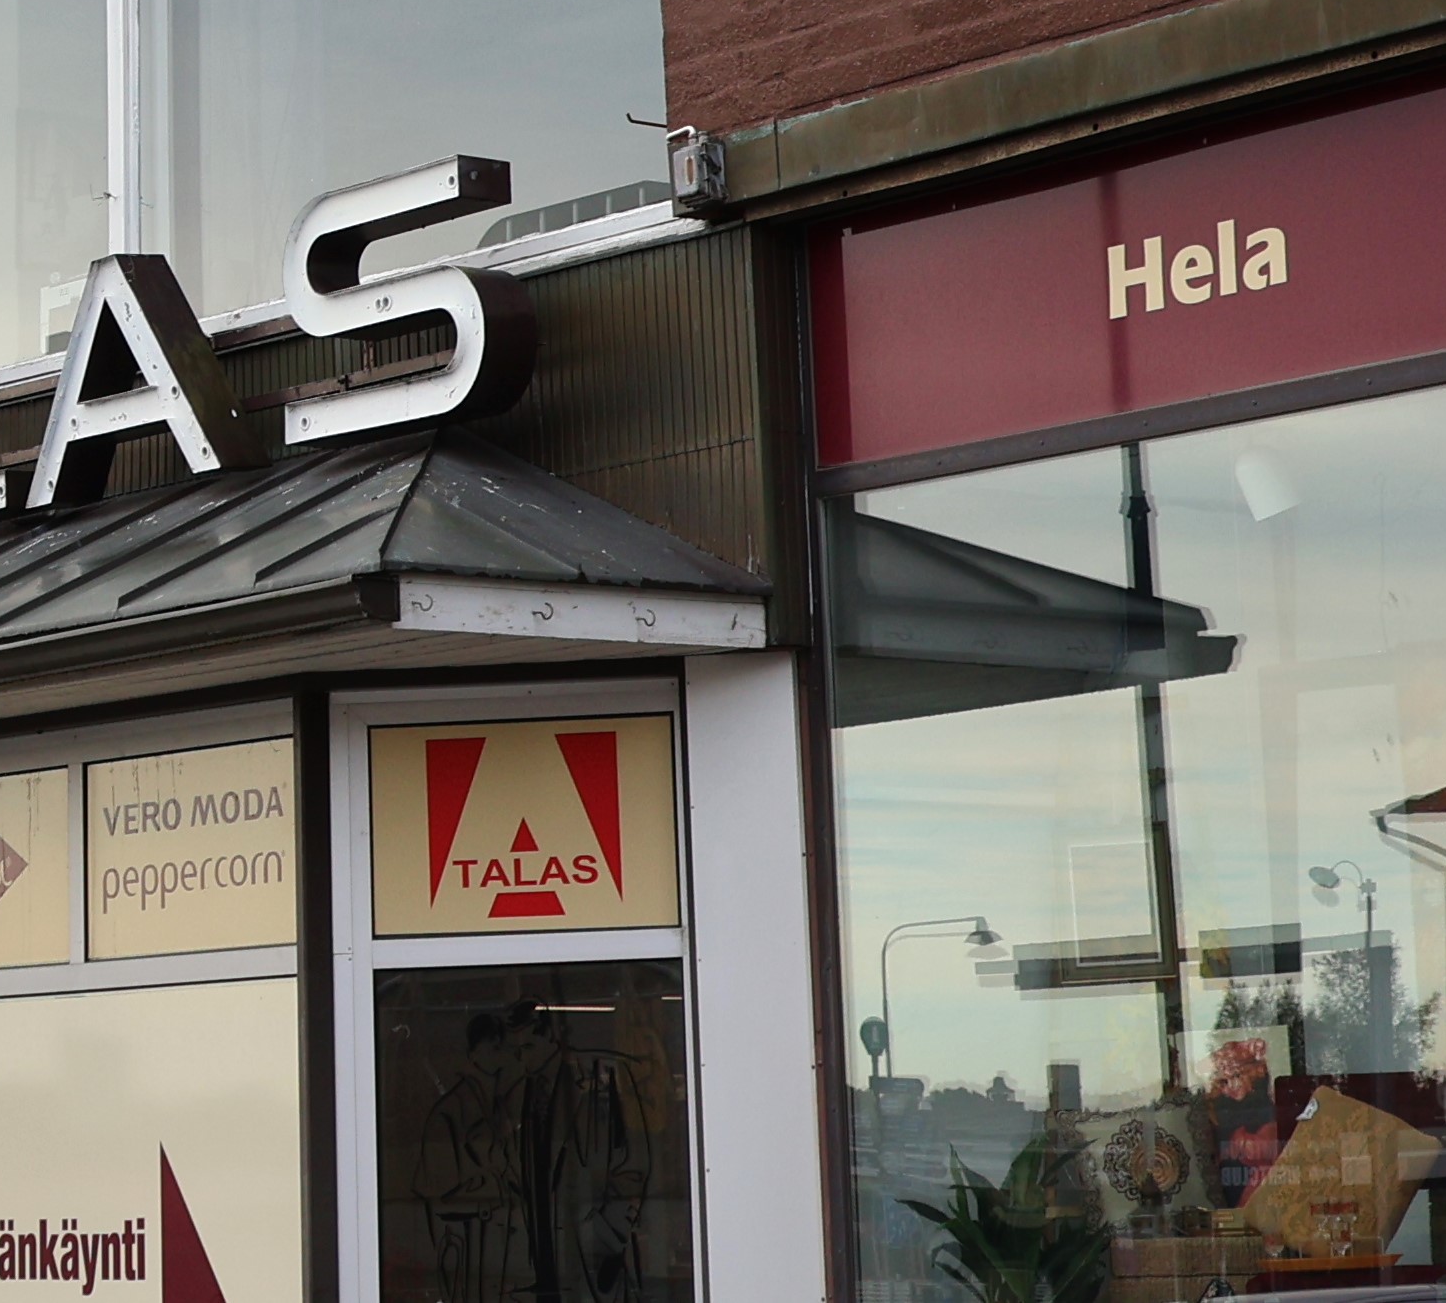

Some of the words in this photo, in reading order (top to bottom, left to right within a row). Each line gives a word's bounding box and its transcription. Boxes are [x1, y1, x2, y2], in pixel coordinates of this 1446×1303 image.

[1107, 218, 1288, 320] Hela
[101, 797, 182, 837] VERO
[189, 785, 285, 828] MODA
[101, 850, 284, 915] peppercorn
[452, 854, 600, 889] TALAS
